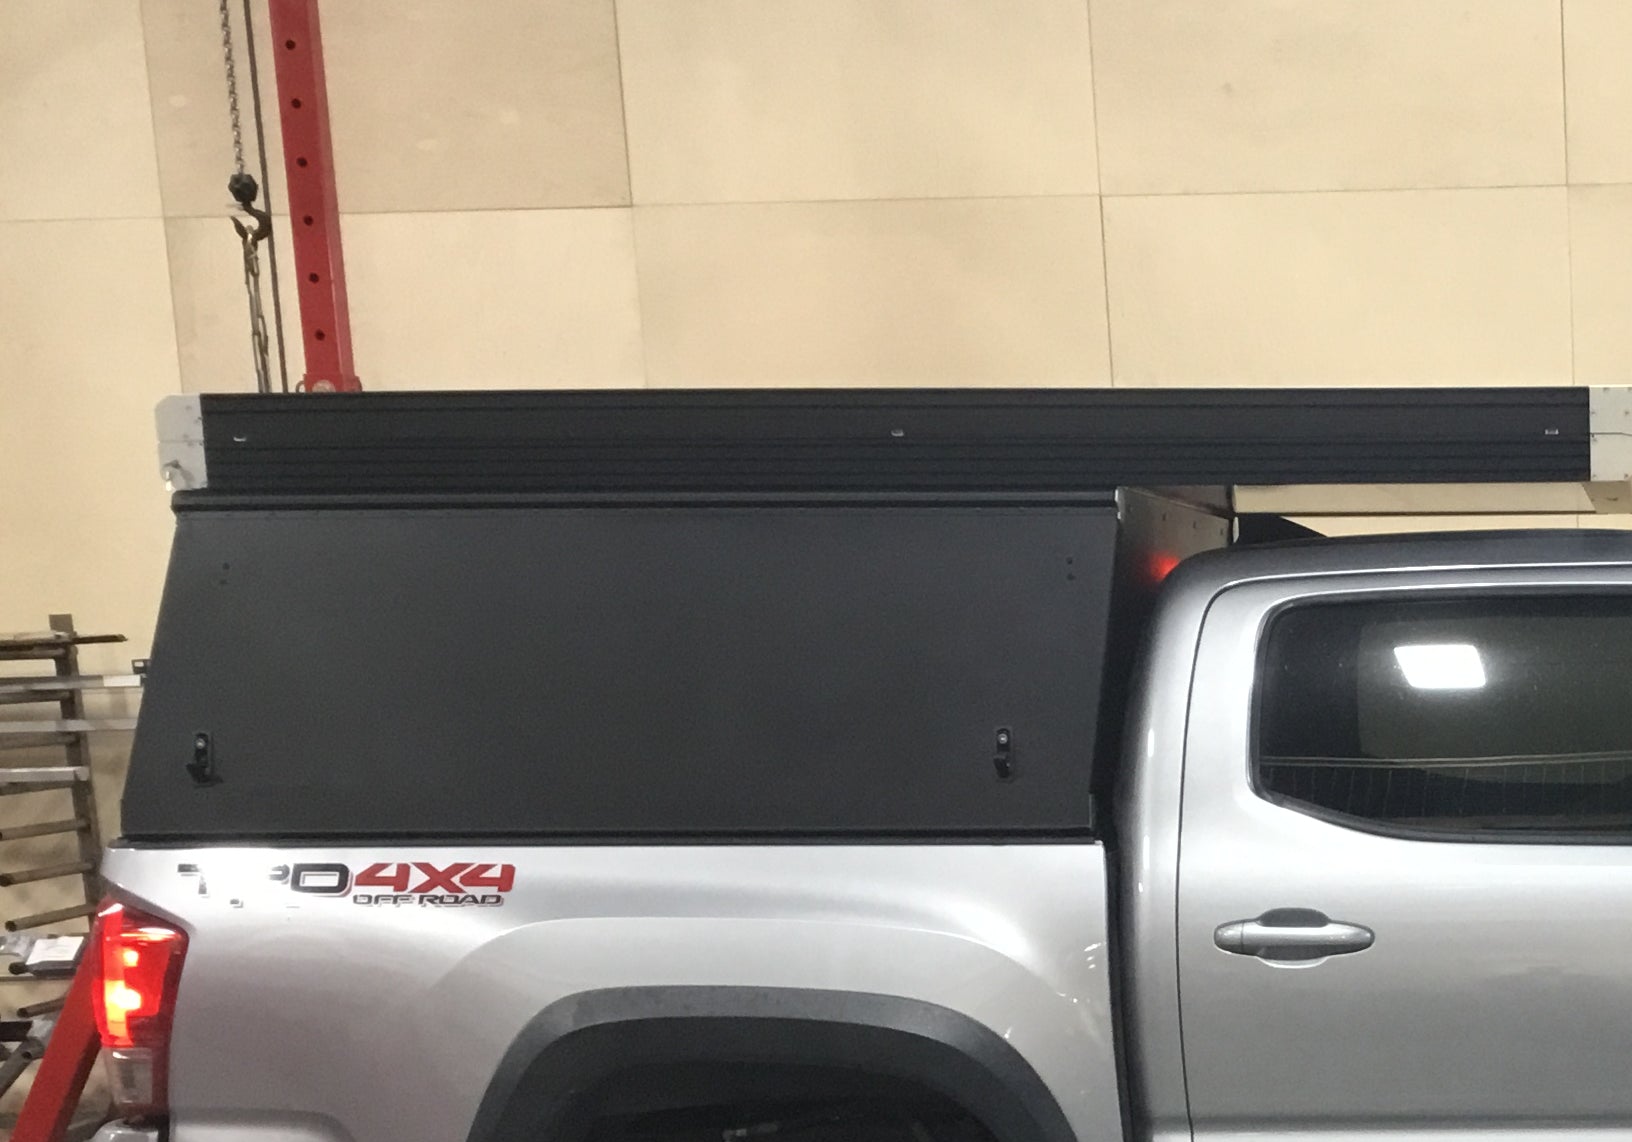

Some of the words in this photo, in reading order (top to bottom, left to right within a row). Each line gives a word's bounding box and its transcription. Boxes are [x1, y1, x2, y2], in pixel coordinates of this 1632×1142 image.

[354, 862, 516, 893] 4X4
[353, 894, 407, 906] OFF
[418, 893, 503, 906] ROAD
